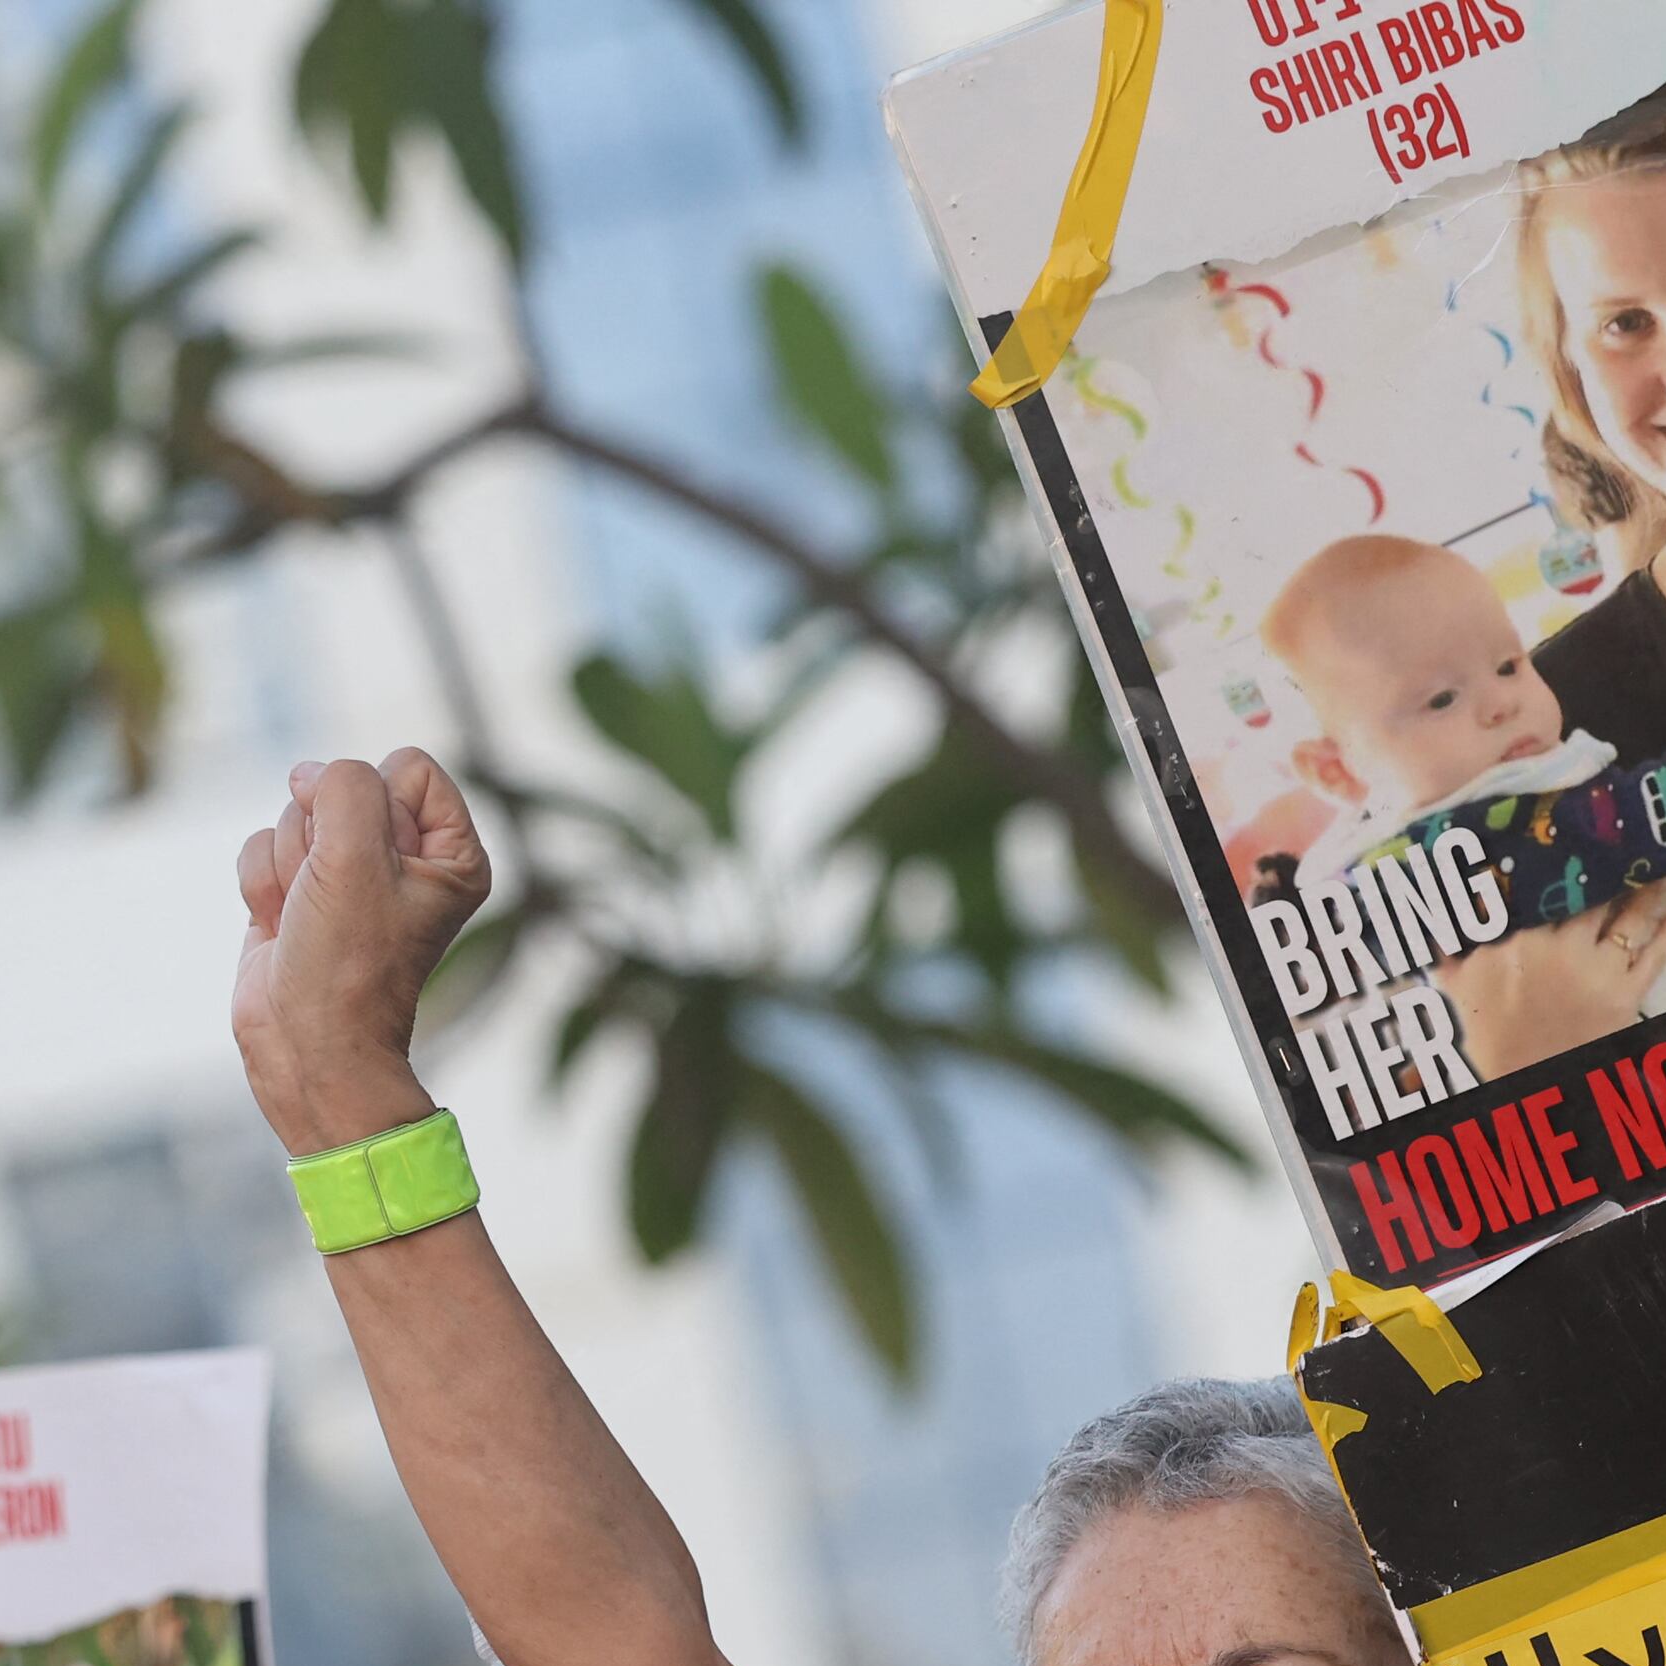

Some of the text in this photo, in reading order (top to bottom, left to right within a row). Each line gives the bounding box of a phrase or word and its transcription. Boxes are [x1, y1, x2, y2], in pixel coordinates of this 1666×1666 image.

[1248, 0, 1526, 134] SHIRI BIBAS
[1366, 82, 1471, 185] (32)
[1247, 827, 1509, 1018] BRING
[1296, 985, 1486, 1141] HER
[1347, 1086, 1600, 1274] HOME
